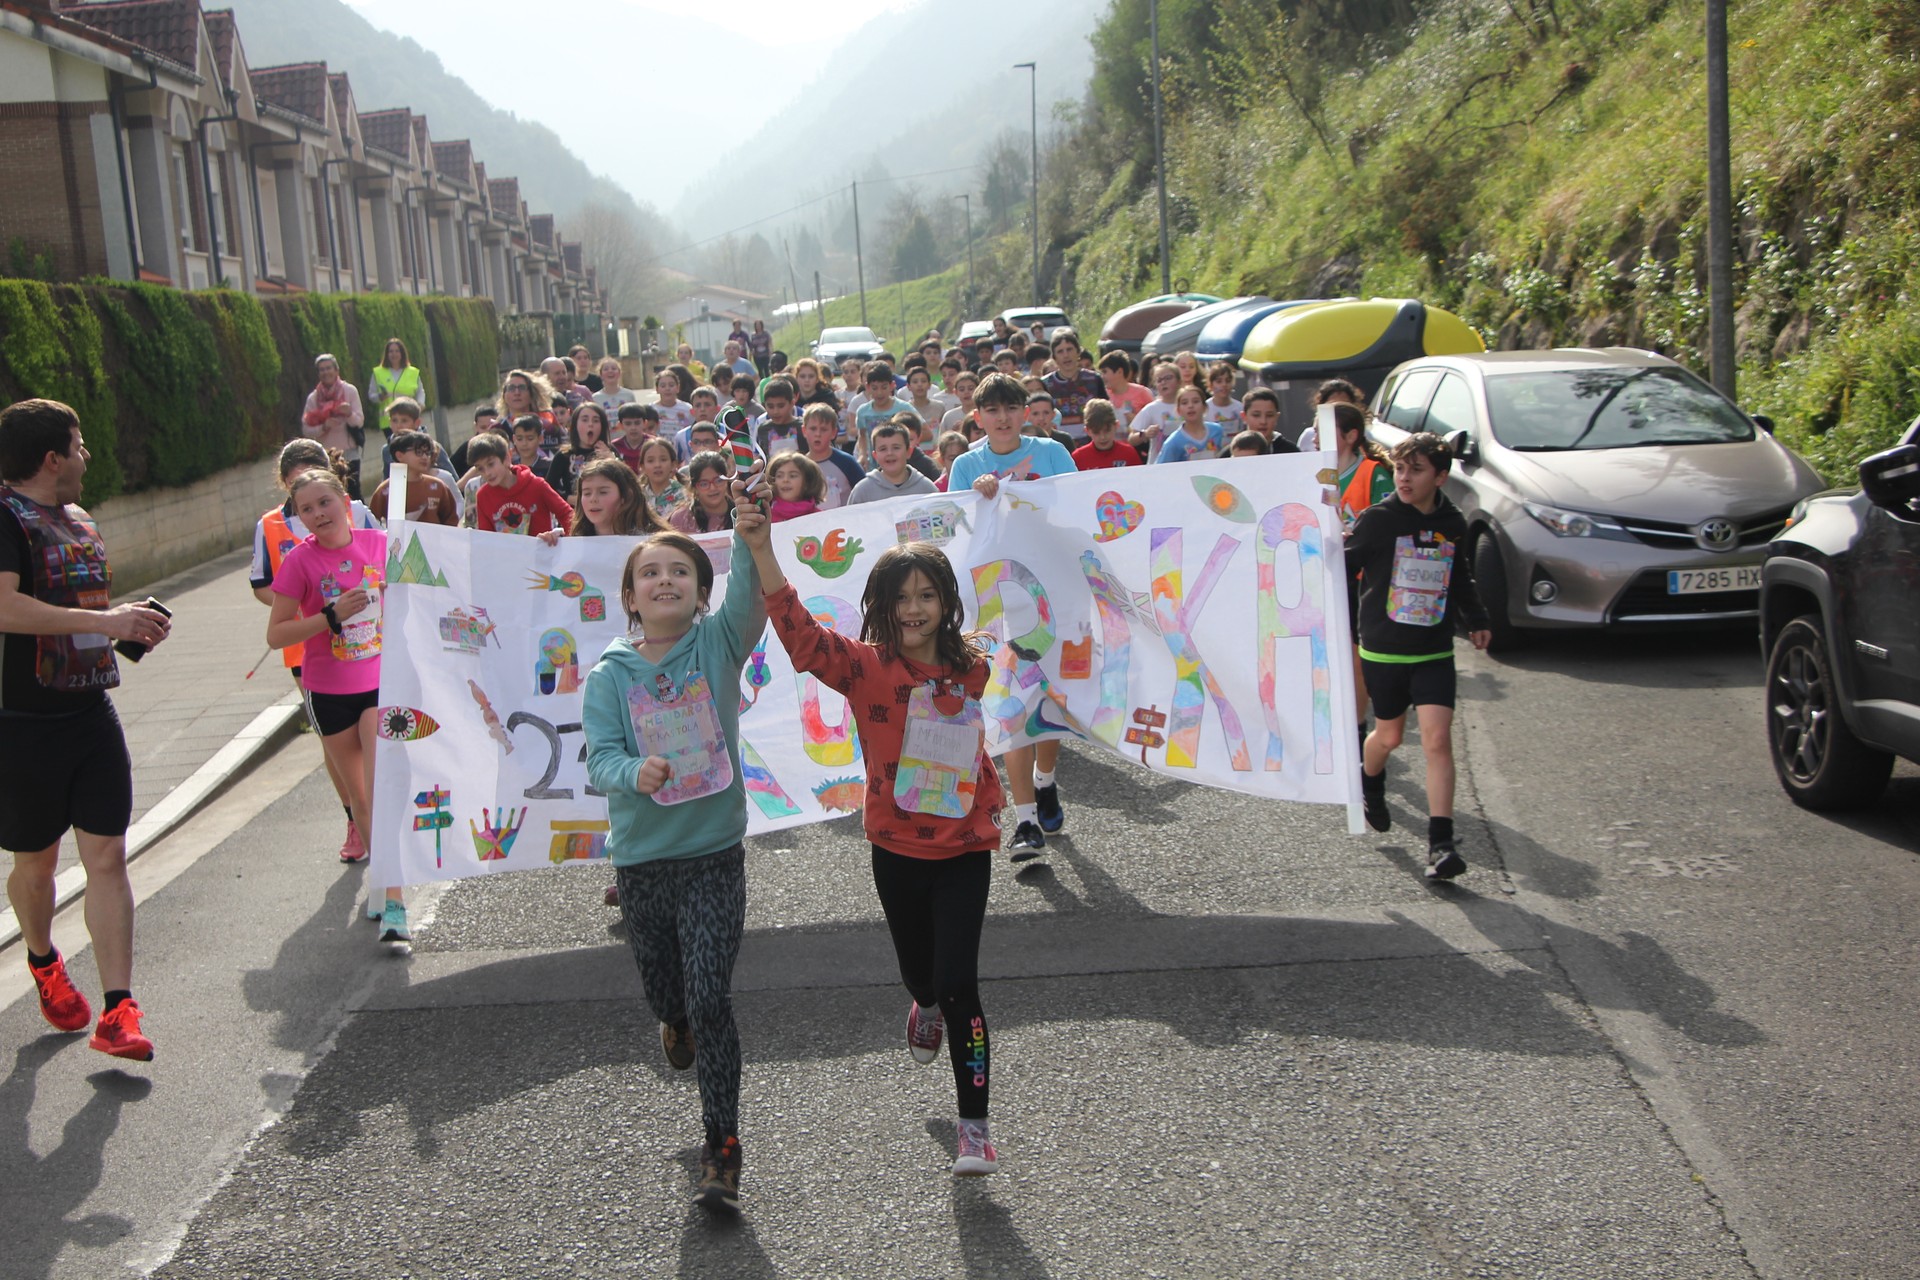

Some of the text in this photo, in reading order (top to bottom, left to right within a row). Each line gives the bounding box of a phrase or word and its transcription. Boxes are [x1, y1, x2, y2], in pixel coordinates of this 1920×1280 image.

[1400, 567, 1445, 583] MENDARO
[1682, 569, 1761, 590] 7285 HX
[1409, 594, 1428, 608] 23
[68, 665, 119, 688] 23.kor
[645, 703, 704, 729] MENDARO
[648, 721, 700, 743] IKASTOLA
[966, 1016, 985, 1087] adidas
